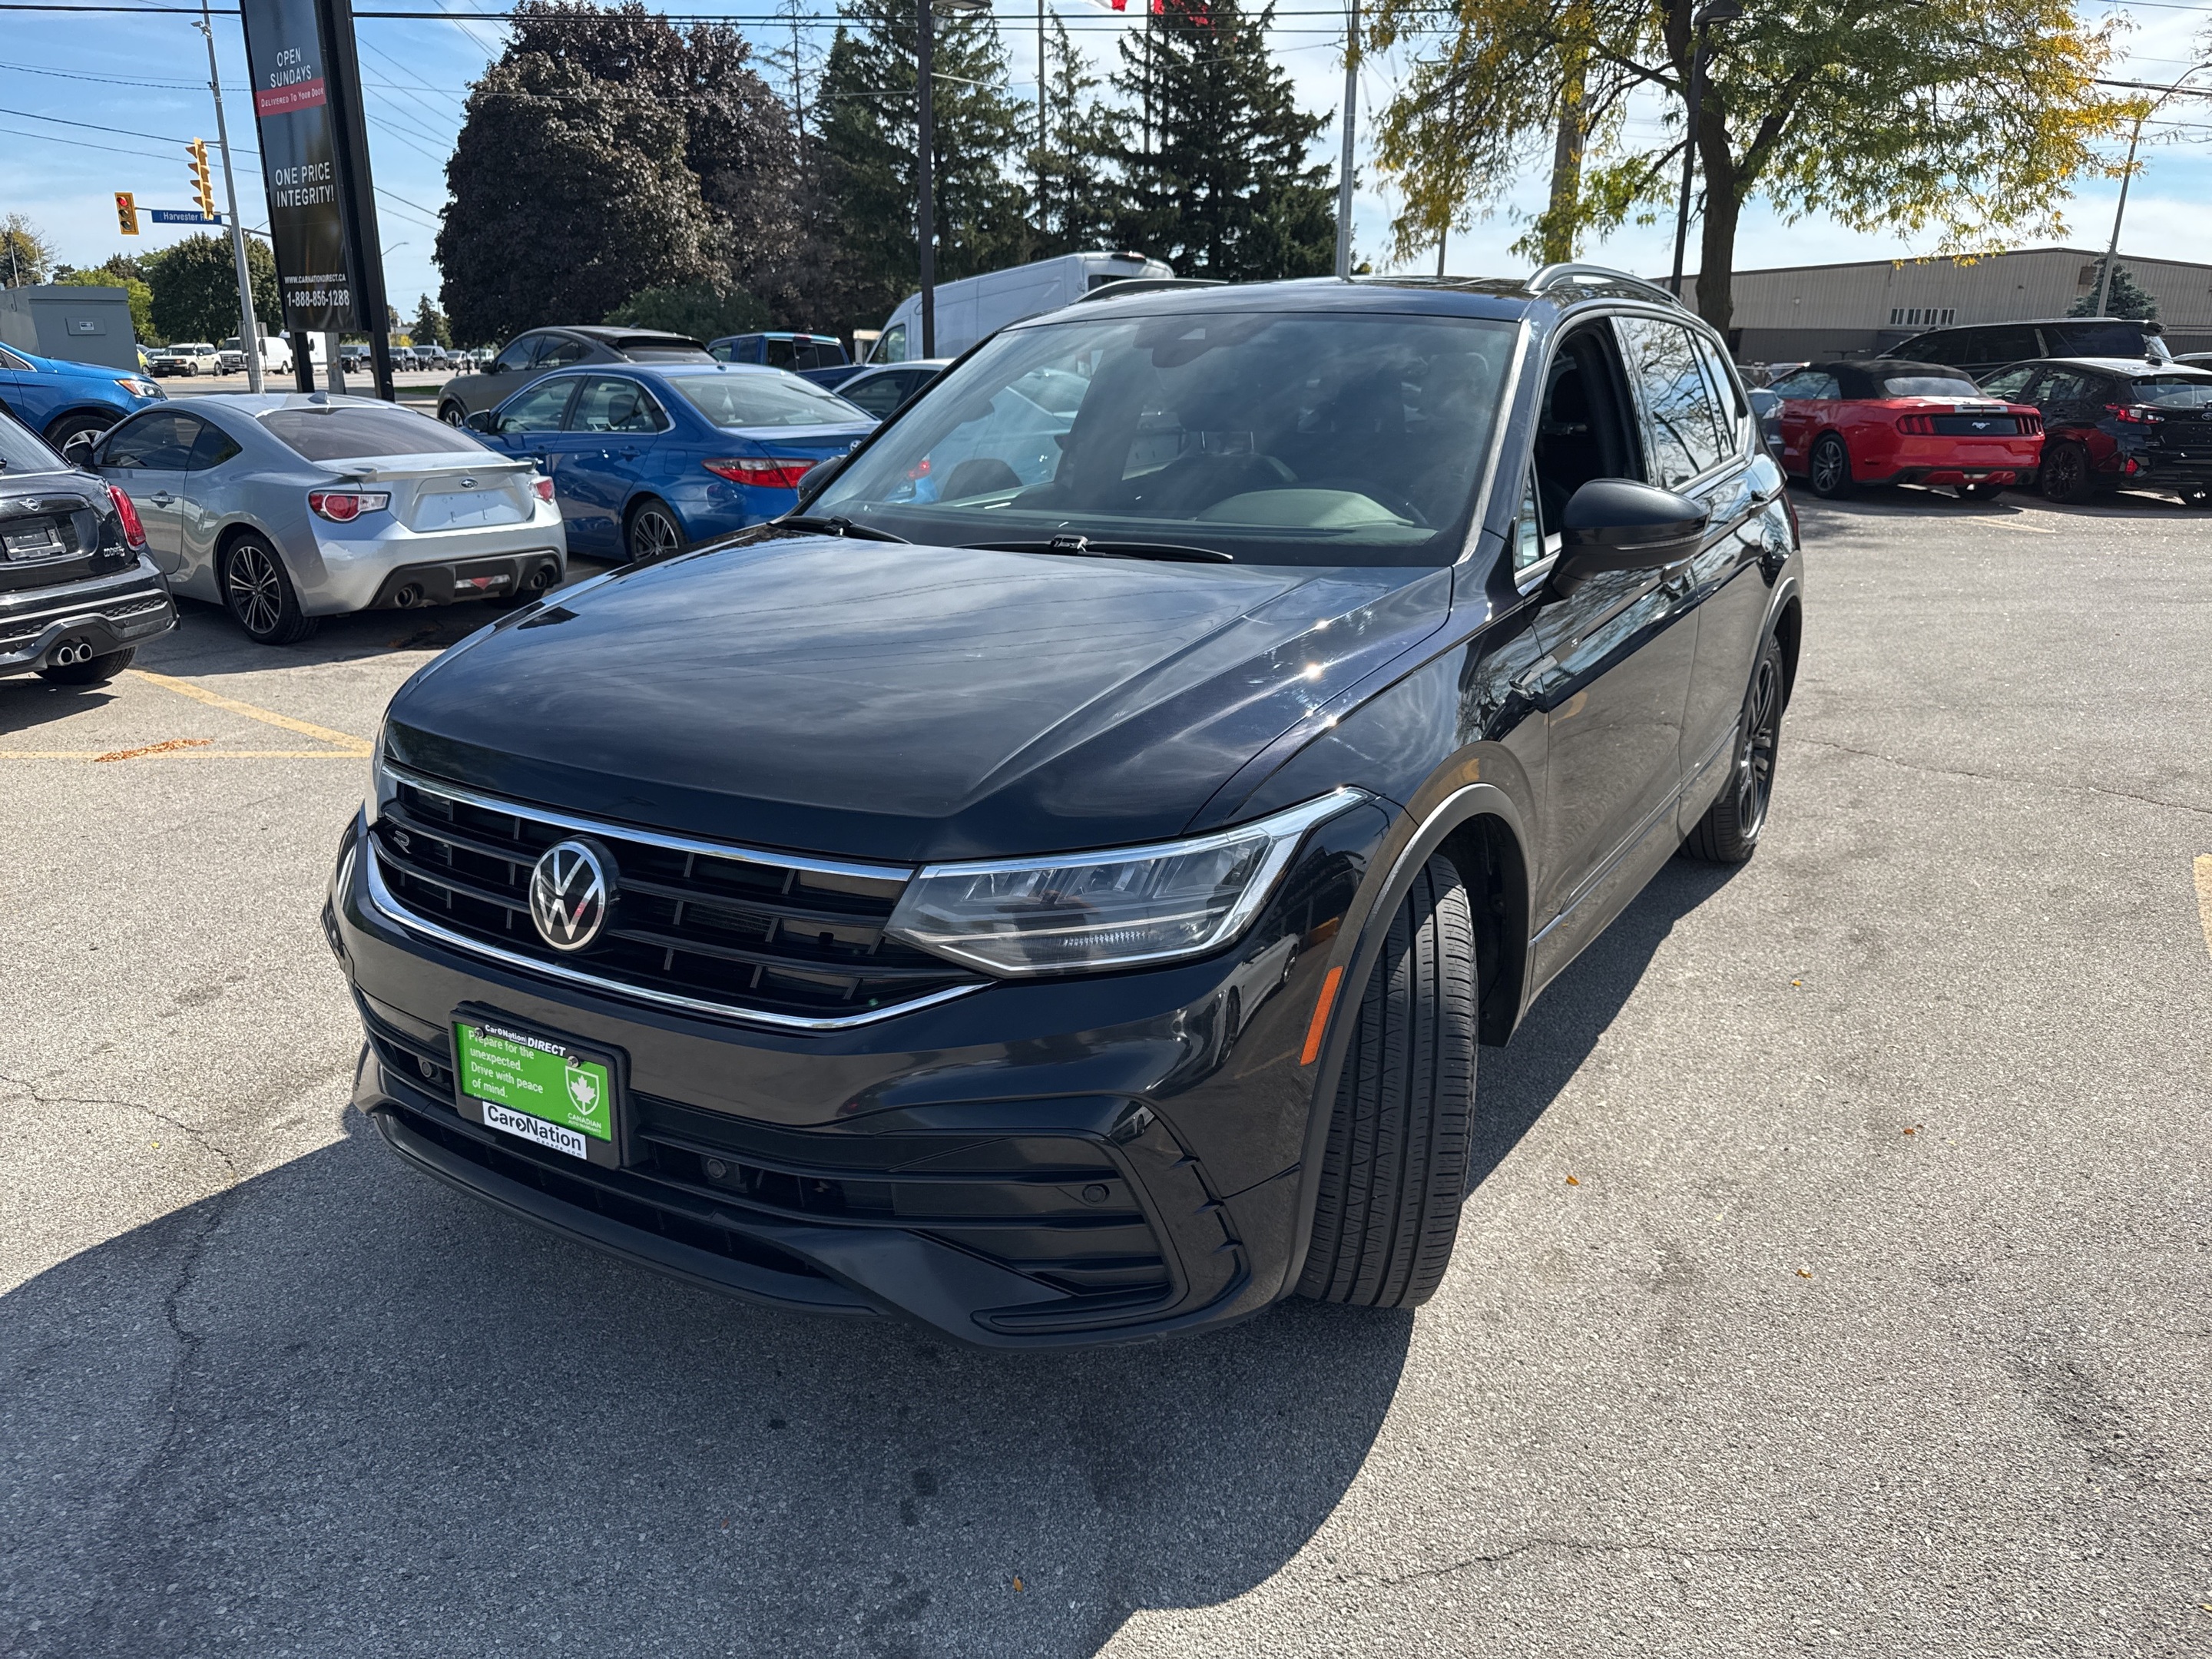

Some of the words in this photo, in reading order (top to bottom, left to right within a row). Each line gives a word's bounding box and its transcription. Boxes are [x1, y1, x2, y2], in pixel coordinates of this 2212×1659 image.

[276, 47, 301, 67] OPEN
[270, 65, 312, 88] SUNDAYS
[275, 167, 298, 186] ONE
[301, 161, 331, 184] PRICE
[276, 184, 334, 207] INTEGRITY!
[163, 211, 198, 222] Harvester
[286, 289, 350, 307] 1-888-856-1288
[505, 1040, 518, 1054] for
[519, 1045, 535, 1059] the
[527, 1037, 567, 1057] DIRECT
[469, 1048, 524, 1071] unexpected.
[471, 1061, 494, 1078] Drive
[495, 1070, 515, 1084] with
[516, 1077, 544, 1094] peace
[472, 1078, 481, 1089] of
[483, 1082, 508, 1098] mind.
[568, 1112, 602, 1129] CANADIAN
